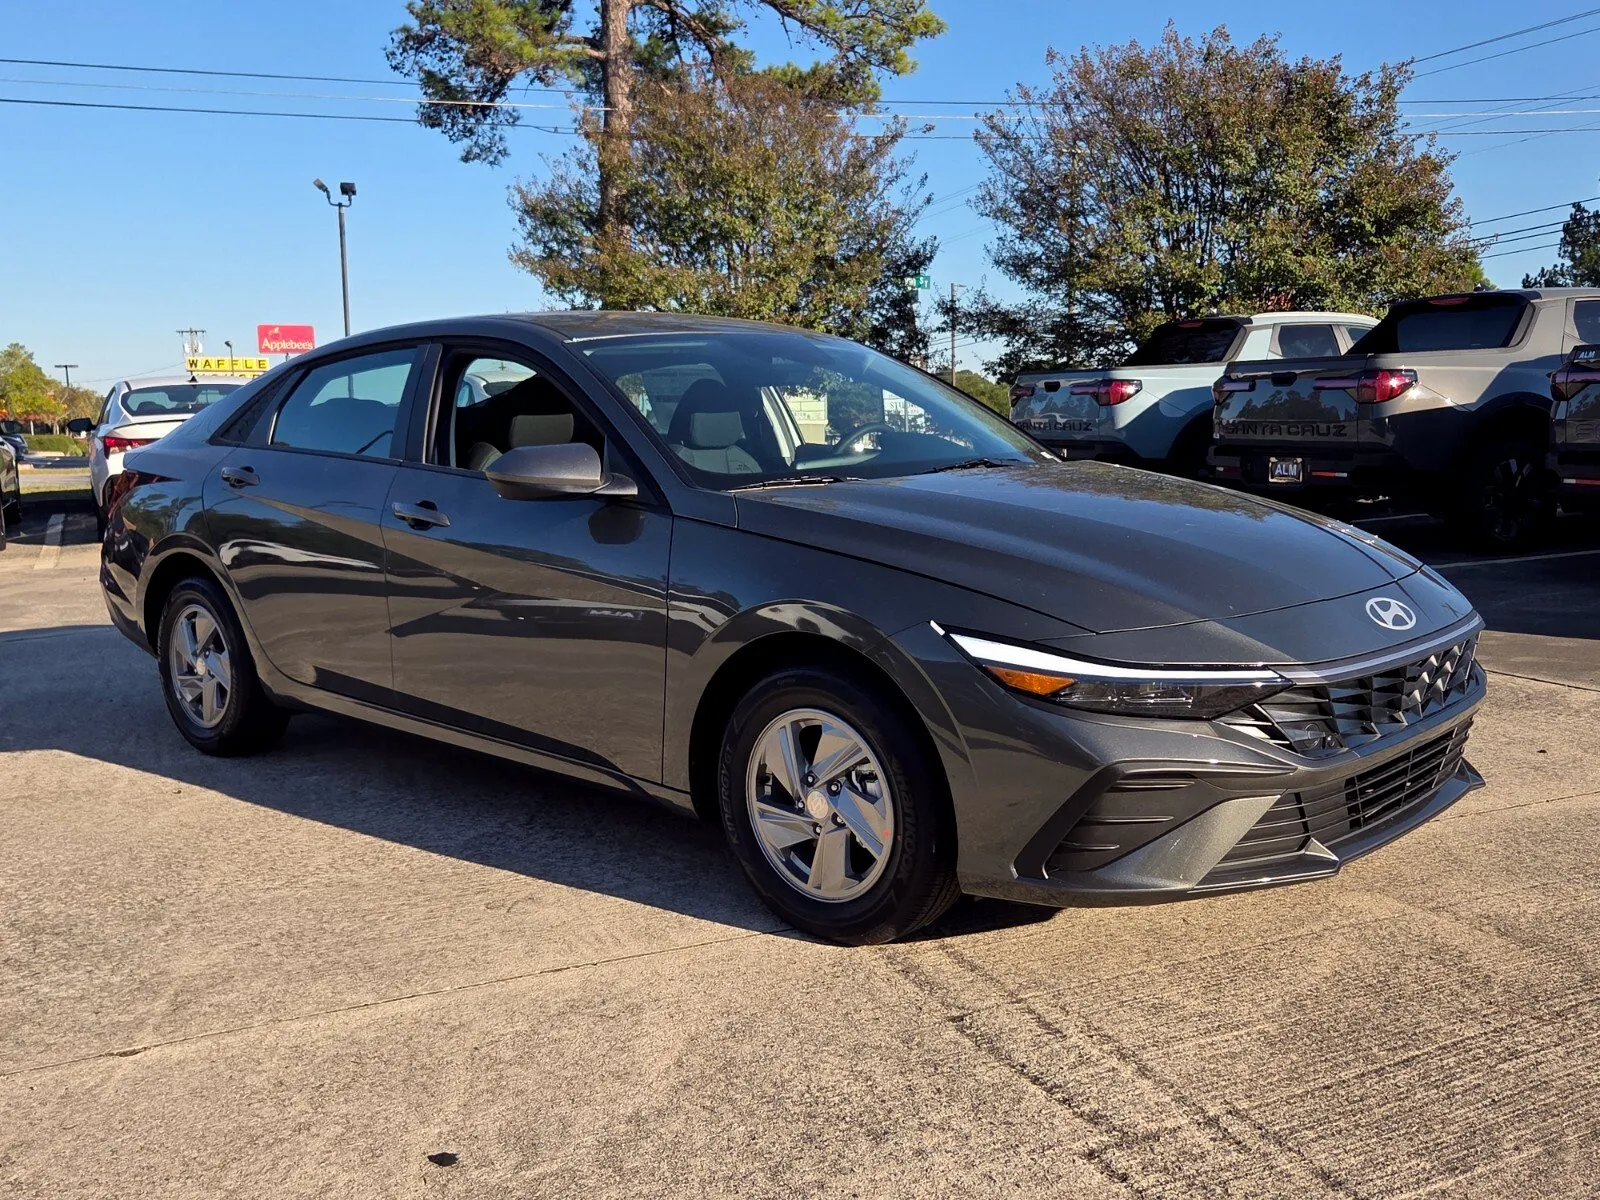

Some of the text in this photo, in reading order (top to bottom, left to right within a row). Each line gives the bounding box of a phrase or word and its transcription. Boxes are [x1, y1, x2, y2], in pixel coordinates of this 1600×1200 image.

[1578, 350, 1596, 359] ALM
[188, 359, 267, 369] WAFFLE
[1053, 422, 1092, 431] CRUZ
[1225, 423, 1347, 437] SANTA CRUZ
[1275, 464, 1297, 476] ALM
